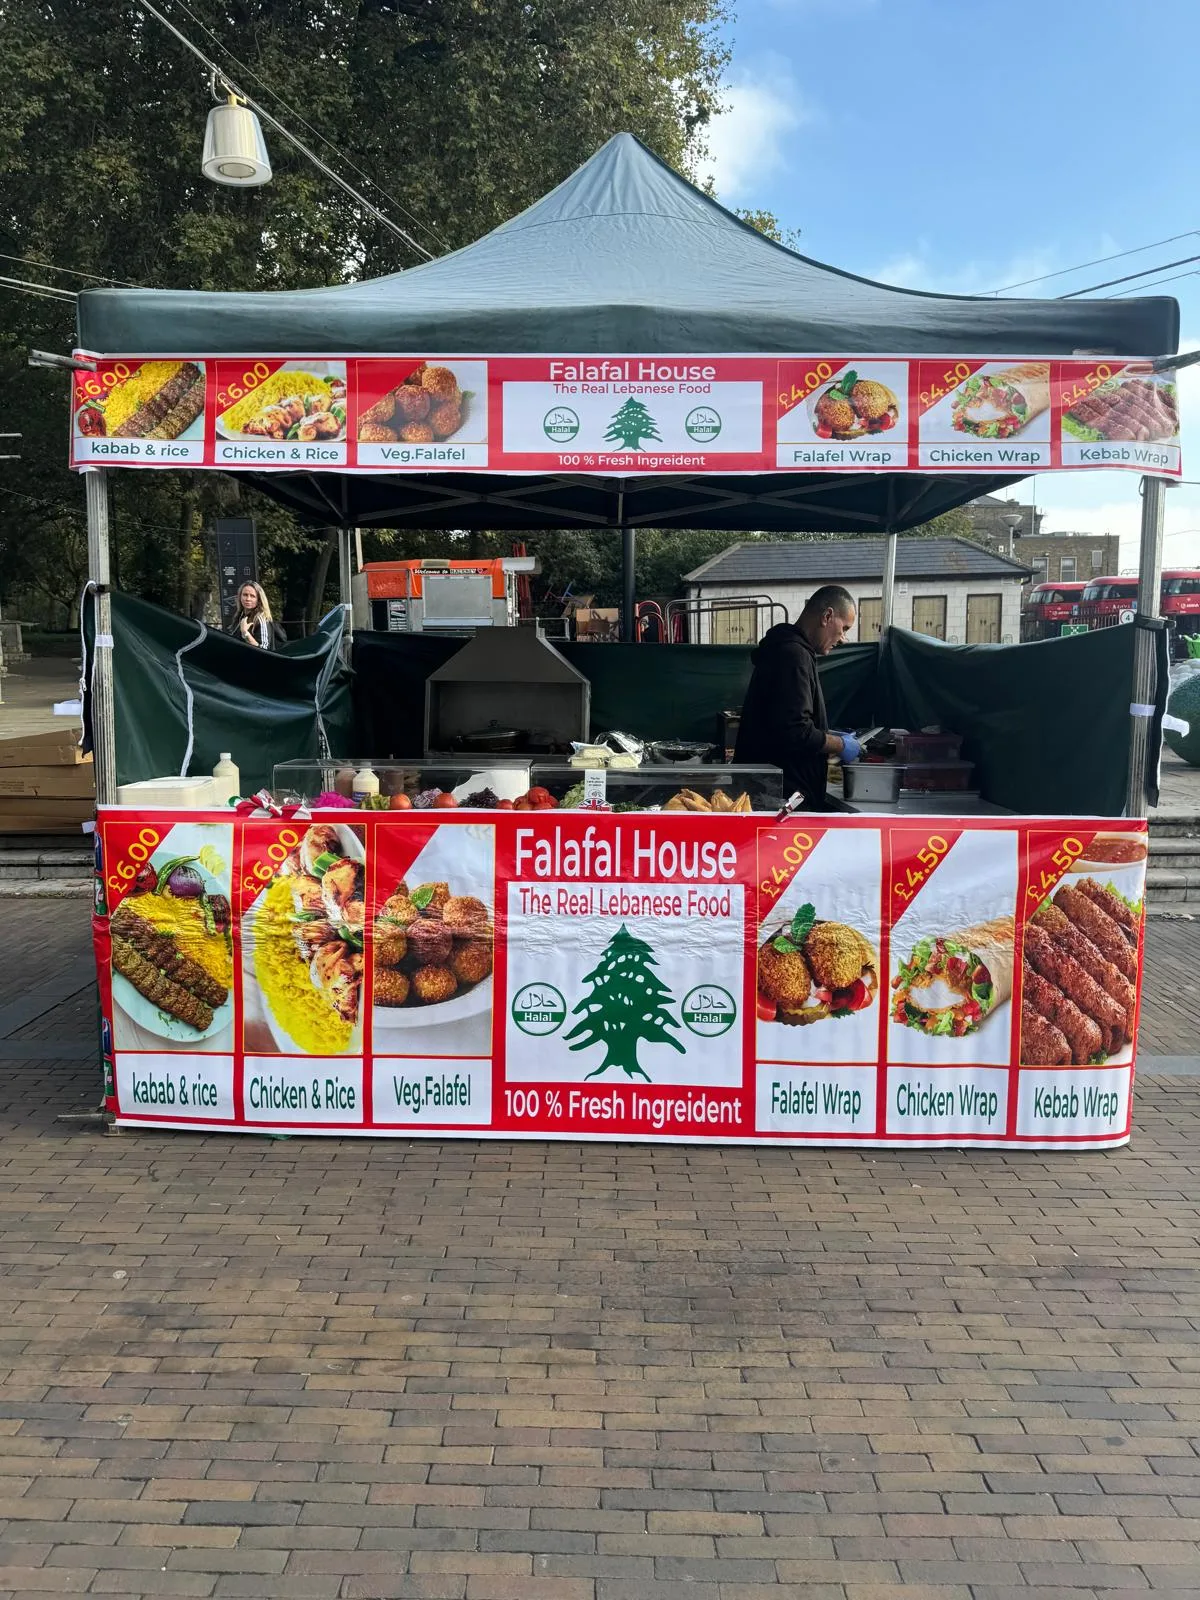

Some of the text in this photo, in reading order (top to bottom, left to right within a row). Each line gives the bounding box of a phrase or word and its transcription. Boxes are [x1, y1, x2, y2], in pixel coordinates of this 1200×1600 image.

[75, 362, 131, 403] £6.00
[217, 361, 270, 407] £6.00
[550, 361, 716, 381] Falafal House
[554, 384, 711, 395] The Real Lebanese Food
[778, 362, 832, 409] £4.00
[920, 363, 970, 408] £4.50
[1061, 364, 1111, 407] £4.50
[91, 441, 189, 457] kabab & rice
[222, 446, 339, 461] Chicken & Rice
[381, 447, 465, 462] Veg.Falafel
[558, 455, 706, 468] 100 % Fresh Ingreident
[793, 450, 892, 464] Falafel Wrap
[930, 450, 1041, 464] Chicken Wrap
[1080, 448, 1169, 466] Kebab Wrap
[108, 827, 161, 894] £6.00
[243, 828, 300, 894] £6.00
[515, 825, 738, 879] Falafal House
[760, 832, 813, 899] £4.00
[893, 834, 948, 901] £4.50
[1027, 836, 1084, 902] £4.50
[519, 887, 731, 917] The Real Lebanese Food
[520, 992, 557, 1010] حلال
[524, 1012, 552, 1022] Halal
[690, 994, 727, 1011] حلال
[693, 1013, 722, 1023] Halal
[132, 1072, 174, 1105] kabab
[176, 1078, 189, 1106] &
[192, 1078, 218, 1107] rice
[249, 1077, 356, 1110] Chicken & Rice
[393, 1074, 471, 1113] Veg.Falafel
[771, 1081, 862, 1124] Falafel Wrap
[896, 1083, 998, 1126] Chicken Wrap
[1033, 1084, 1119, 1126] Kebab Wrap
[505, 1089, 742, 1128] 100 % Fresh Ingreident
